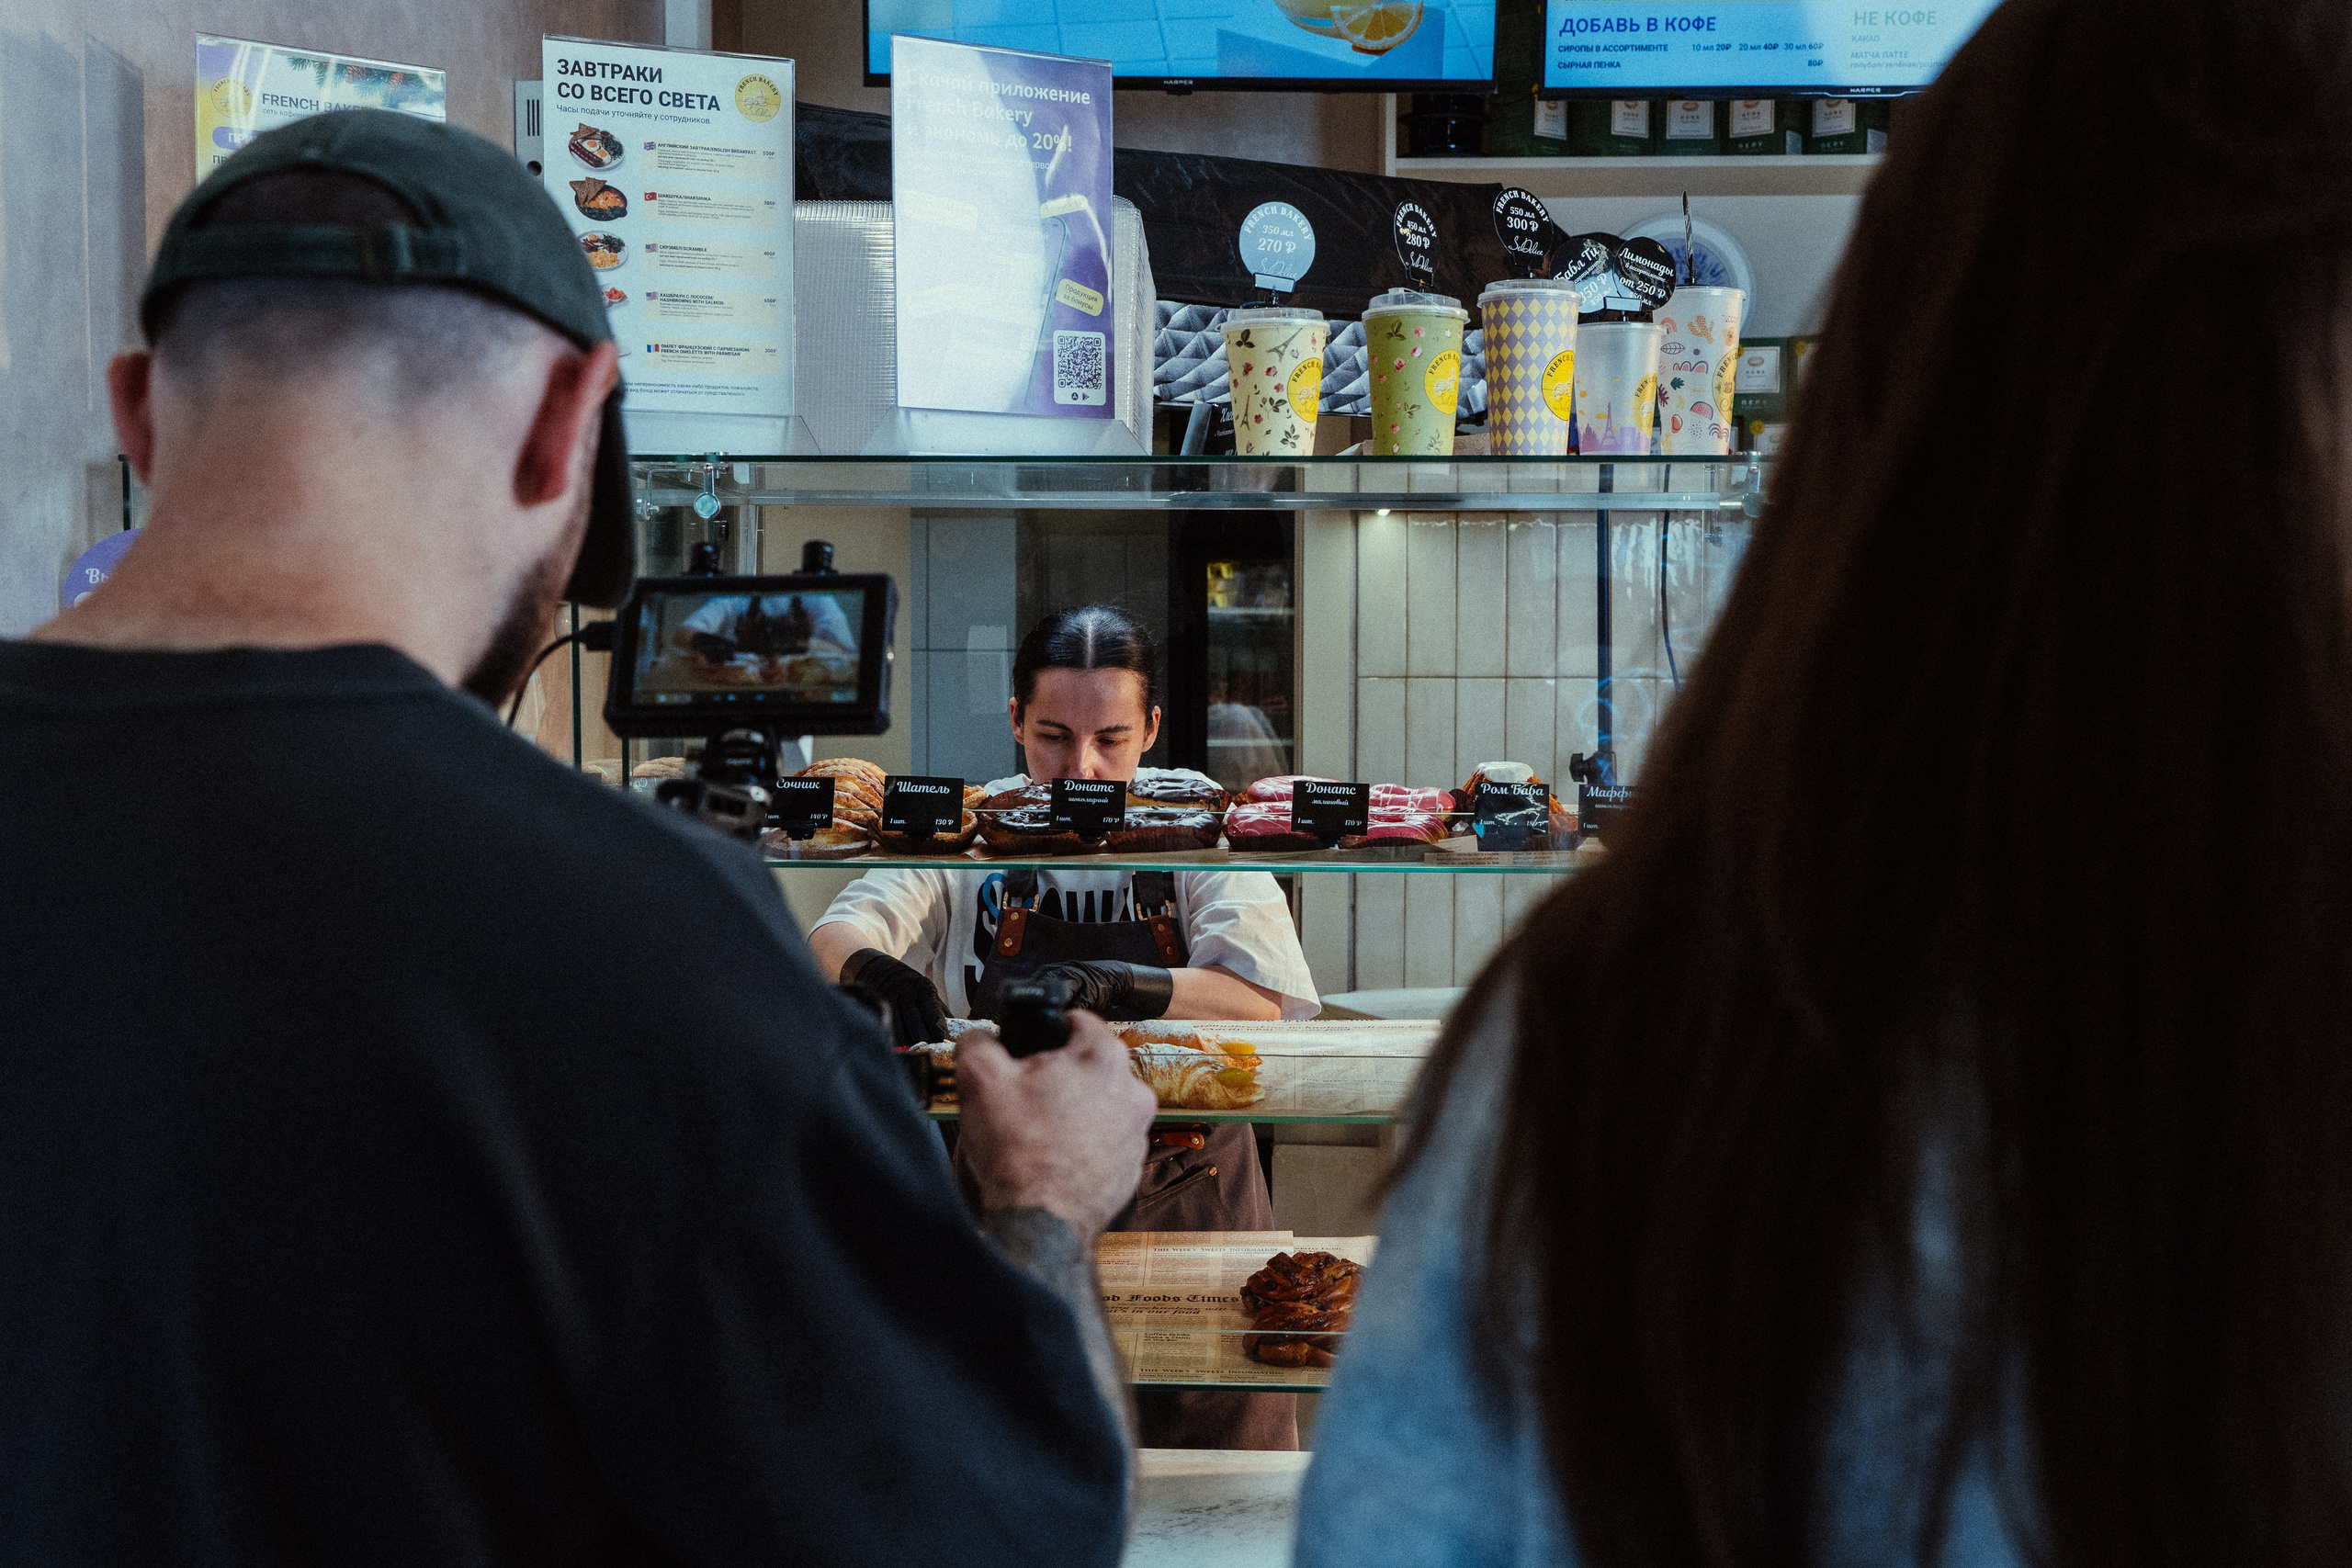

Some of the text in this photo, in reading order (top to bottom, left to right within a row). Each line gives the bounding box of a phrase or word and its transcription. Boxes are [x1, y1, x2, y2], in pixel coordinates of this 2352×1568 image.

[1853, 10, 1938, 26] НЕ КОФЕ
[1559, 16, 1716, 37] ДОБАВЬ В КОФЕ
[1557, 44, 1594, 52] СИРОПЫ
[1595, 44, 1600, 52] В
[1602, 44, 1668, 52] АССОРТИМЕНТЕ
[1692, 43, 1701, 51] 10
[1738, 43, 1748, 51] 20
[1783, 42, 1793, 51] 30
[1882, 51, 1909, 59] ЛАТТЕ
[557, 58, 662, 84] ЗАВТРАКИ
[1557, 61, 1592, 69] СЫРНАЯ
[1593, 61, 1622, 69] ПЕНКА
[738, 76, 779, 96] FRENCH BAKERY
[978, 81, 1091, 107] приложение
[262, 93, 320, 112] FRENCH
[557, 83, 721, 112] СО ВСЕГО СВЕТА
[262, 107, 278, 116] сеть
[556, 104, 579, 114] Часы
[580, 107, 610, 117] подачи
[611, 108, 652, 121] уточняйте
[660, 113, 713, 125] сотрудников.
[906, 94, 1034, 129] French Bakery
[1004, 133, 1028, 152] до
[657, 193, 711, 202] ШАКШУКА/SHAKSHUKA
[1496, 189, 1550, 222] FRENCH BAKERY
[1510, 206, 1524, 217] 550
[1244, 205, 1312, 241] FRENCH BAKERY
[1396, 202, 1438, 238] FRENCH BAKERY
[1507, 216, 1528, 231] 300
[1261, 224, 1280, 235] 350
[1418, 225, 1427, 234] мл
[1257, 237, 1283, 253] 270
[1406, 231, 1422, 248] 280
[659, 244, 707, 253] СКРЭМБЛ/SCRAMBLE
[1553, 246, 1600, 281] Бабл Ти
[1619, 247, 1675, 277] Лимонады
[1065, 283, 1099, 303] Продукция
[1619, 276, 1635, 288] от
[1635, 280, 1657, 296] 250
[1070, 295, 1094, 311] бонусы
[1589, 293, 1604, 307] 450
[1292, 360, 1316, 383] FRENCH
[1428, 353, 1452, 376] FRENCH
[1546, 354, 1570, 378] FRENCH
[775, 777, 820, 790] Сочник
[896, 781, 951, 795] Шатель
[1064, 779, 1115, 793] Донатс
[1305, 782, 1357, 795] Донатс
[1480, 783, 1545, 796] Ром Баба
[1068, 796, 1109, 806] шоколадный
[934, 818, 947, 826] 130
[1125, 1294, 1240, 1303] Foods Times
